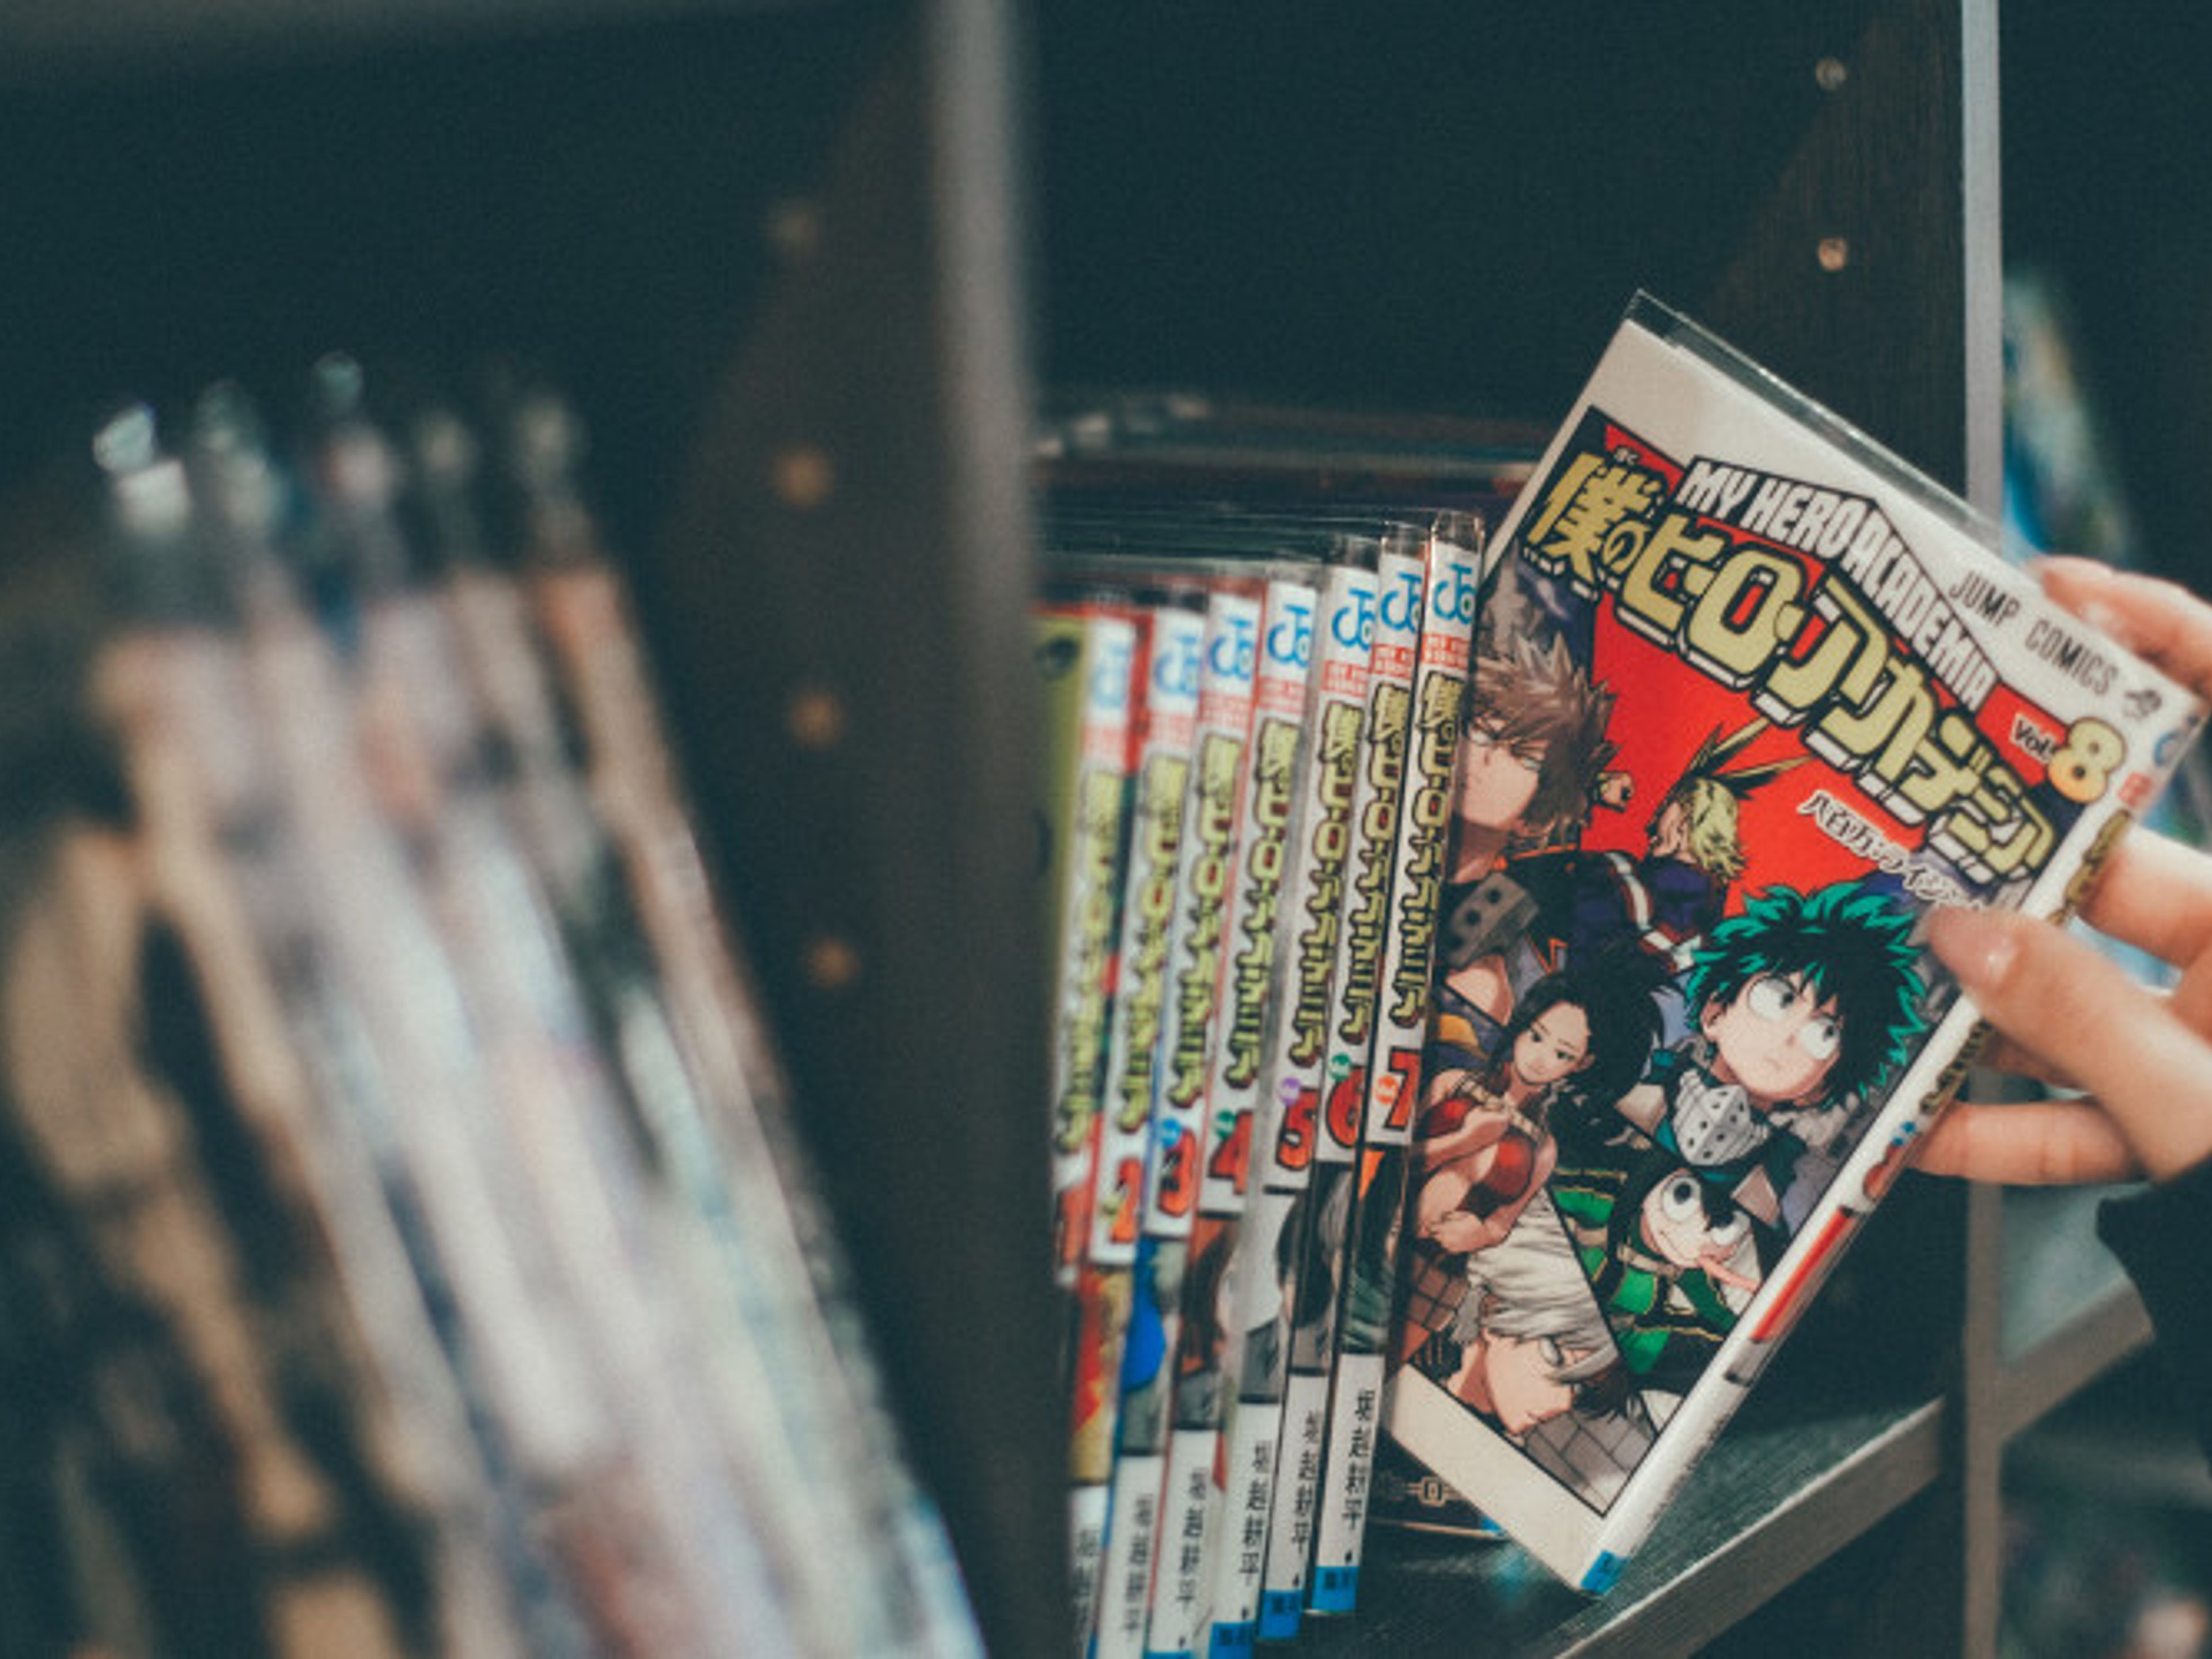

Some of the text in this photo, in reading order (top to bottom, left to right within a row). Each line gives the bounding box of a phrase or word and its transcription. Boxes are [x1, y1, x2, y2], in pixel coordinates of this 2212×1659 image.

[1675, 461, 1999, 713] MY HERO ACADEMIA
[1949, 571, 2120, 696] JUMP COMICS
[1275, 1086, 1318, 1172] 5
[1384, 1047, 1422, 1131] 7
[1157, 1127, 1198, 1218] 3
[1207, 1109, 1253, 1195] 4
